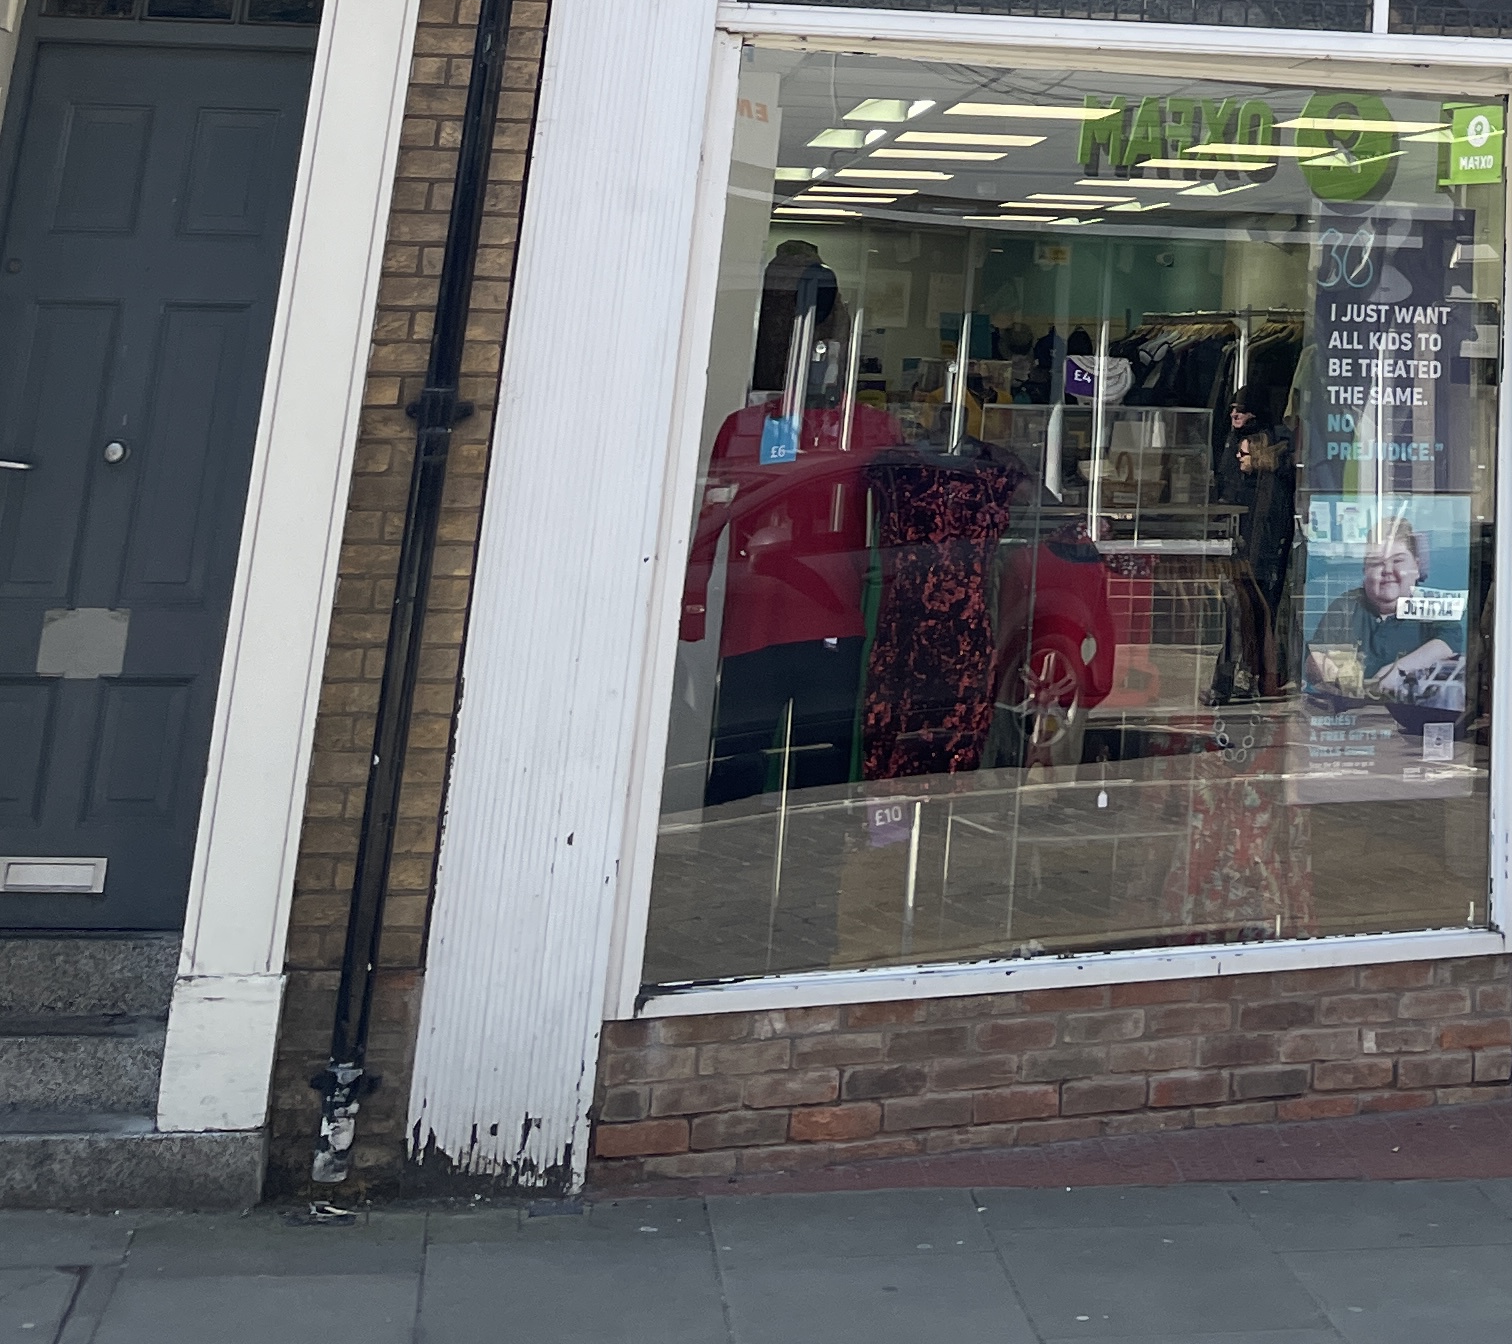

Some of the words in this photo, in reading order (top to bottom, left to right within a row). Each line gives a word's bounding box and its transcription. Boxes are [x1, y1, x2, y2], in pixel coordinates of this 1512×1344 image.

[1330, 303, 1337, 322] I
[1341, 303, 1390, 323] JUST
[1394, 305, 1451, 325] WANT
[1328, 331, 1364, 350] ALL
[1369, 331, 1413, 351] KIDS
[1418, 333, 1442, 352] TO
[1073, 369, 1092, 384] £4
[1328, 358, 1353, 377] BE
[1358, 358, 1442, 379] TREATED
[1327, 385, 1365, 405] THE
[1370, 386, 1428, 406] SAME.
[1327, 413, 1355, 433] NO
[770, 444, 786, 459] £6
[875, 805, 903, 827] £10
